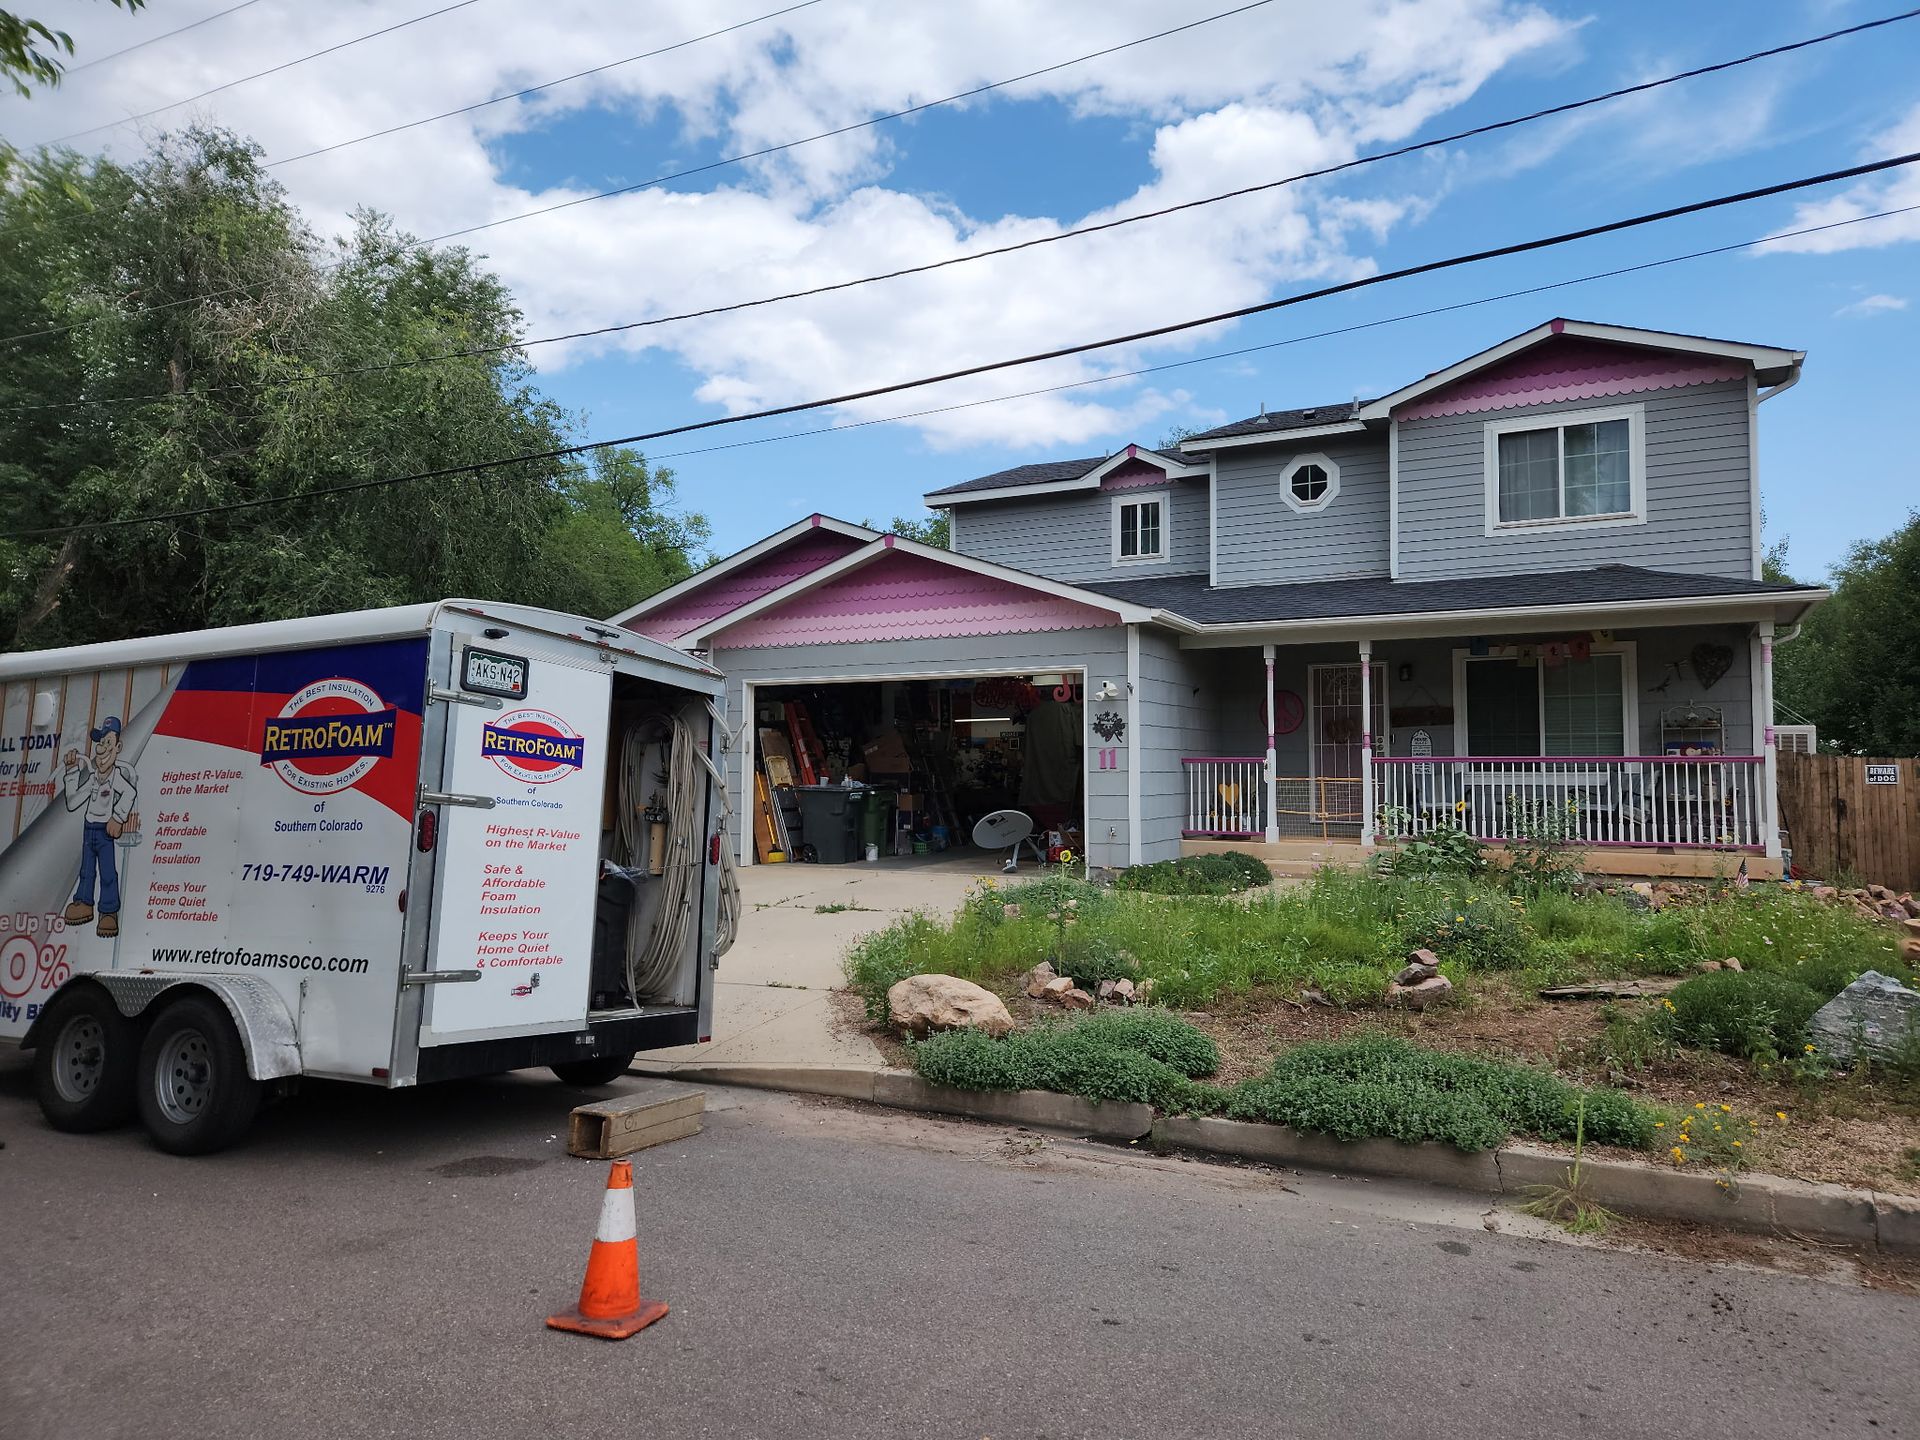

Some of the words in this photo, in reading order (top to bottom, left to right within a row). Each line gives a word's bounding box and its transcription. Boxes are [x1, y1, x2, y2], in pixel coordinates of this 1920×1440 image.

[288, 695, 304, 711] THE
[305, 684, 326, 698] BEST
[328, 683, 375, 707] INSULATION
[503, 715, 515, 725] THE
[19, 733, 61, 751] TODAY
[1098, 747, 1117, 769] 11
[14, 760, 41, 778] your
[1869, 767, 1895, 775] BEWARE
[162, 771, 201, 783] Highest
[203, 769, 242, 780] R-Value
[282, 763, 297, 781] FOR
[298, 776, 334, 789] EXISTING
[9, 778, 56, 797] Estimate
[160, 786, 173, 796] on
[176, 785, 192, 795] the
[194, 784, 229, 794] Market
[527, 787, 537, 795] of
[313, 801, 326, 813] of
[496, 796, 530, 807] Southern
[531, 799, 563, 809] Colorado
[157, 812, 180, 823] Safe
[182, 812, 190, 822] &
[155, 826, 207, 837] Affordable
[274, 820, 316, 832] Southern
[319, 819, 363, 832] Colorado
[486, 824, 533, 837] Highest
[536, 828, 580, 840] R-Value
[154, 840, 182, 851] Foam
[485, 839, 501, 848] on
[505, 839, 524, 849] the
[527, 840, 567, 851] Market
[152, 854, 201, 865] Insulation
[242, 864, 390, 885] 719-749-WARM
[483, 864, 511, 875] Safe
[515, 864, 523, 875] &
[150, 881, 180, 894] Keeps
[183, 882, 207, 893] Your
[365, 884, 385, 894] 9276
[482, 878, 546, 889] Affordable
[147, 896, 176, 907] Home
[178, 896, 207, 908] Quiet
[481, 891, 517, 902] Foam
[146, 909, 153, 920] &
[156, 909, 218, 922] Comfortable
[480, 904, 541, 915] Insulation
[15, 912, 39, 936] Up
[44, 912, 66, 933] To
[478, 931, 518, 942] Keeps
[522, 930, 549, 940] Your
[477, 945, 514, 955] Home
[518, 943, 549, 954] Quiet
[152, 948, 369, 974] www.retrofoamsoco.com
[477, 958, 485, 968] &
[490, 955, 563, 968] Comfortable
